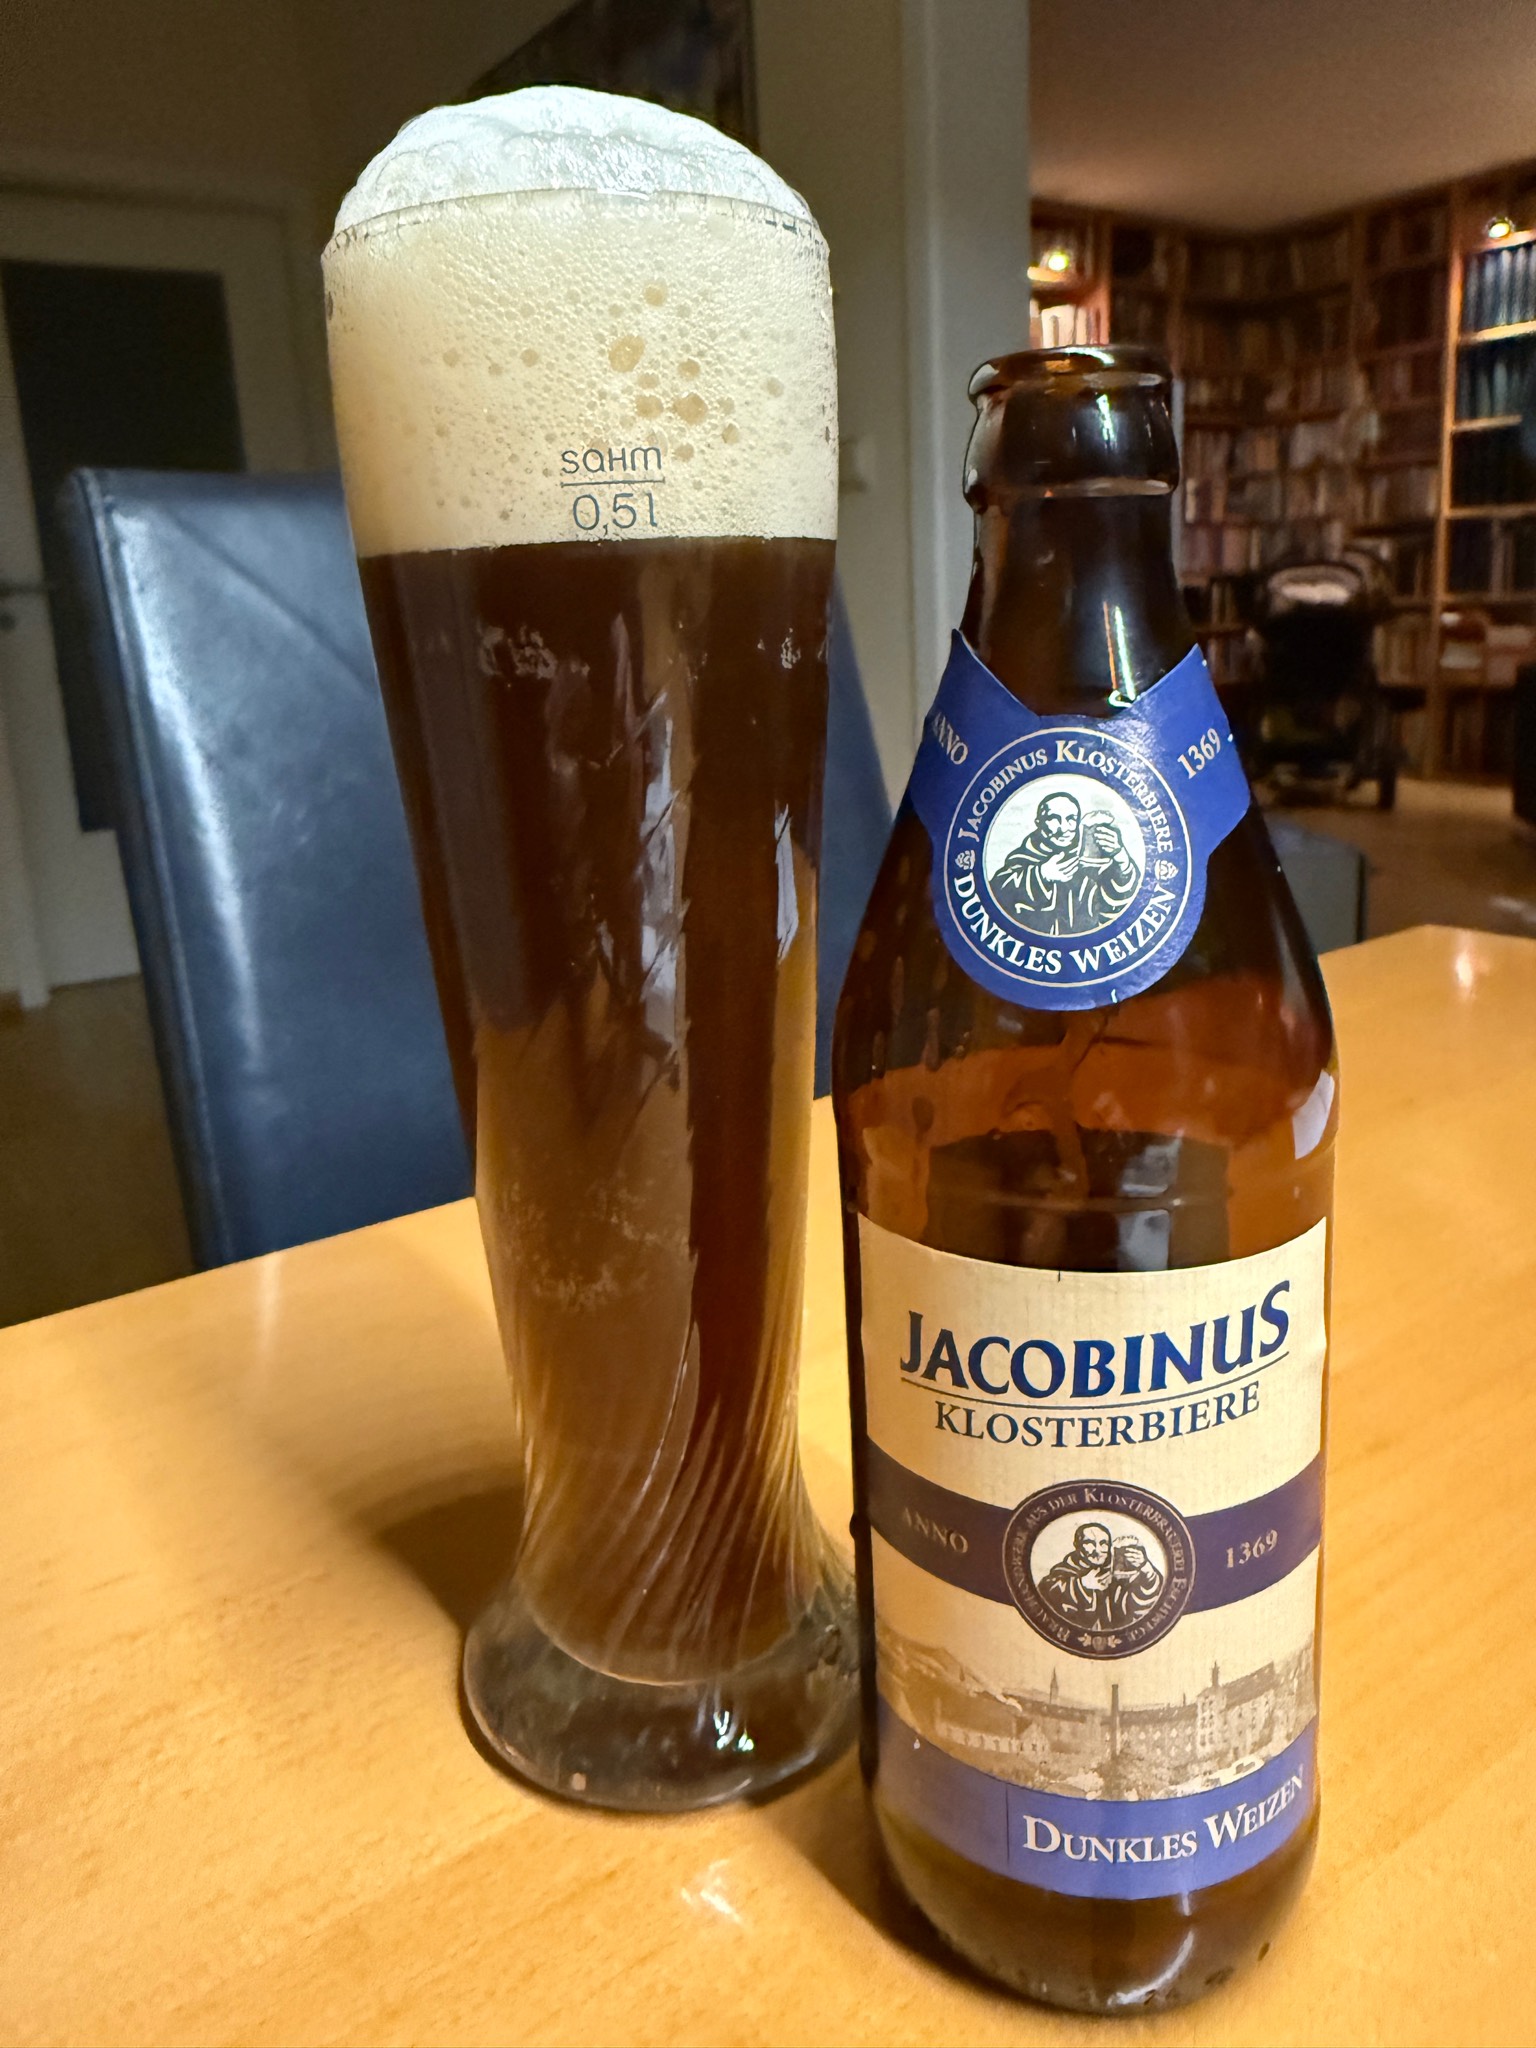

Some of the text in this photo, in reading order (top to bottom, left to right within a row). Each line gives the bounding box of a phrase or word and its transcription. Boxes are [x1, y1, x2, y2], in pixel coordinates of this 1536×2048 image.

[957, 739, 1175, 853] JACOBINUS KLOSTERBIERE
[1177, 727, 1222, 779] 1369
[954, 872, 1176, 974] DUNKLES WEIZEN
[900, 1280, 1291, 1399] JACOBINUS
[935, 1380, 1260, 1448] KLOSTERBIERE
[1224, 1529, 1278, 1569] 1369
[1022, 1764, 1304, 1864] DUNKLES WEIZEN
